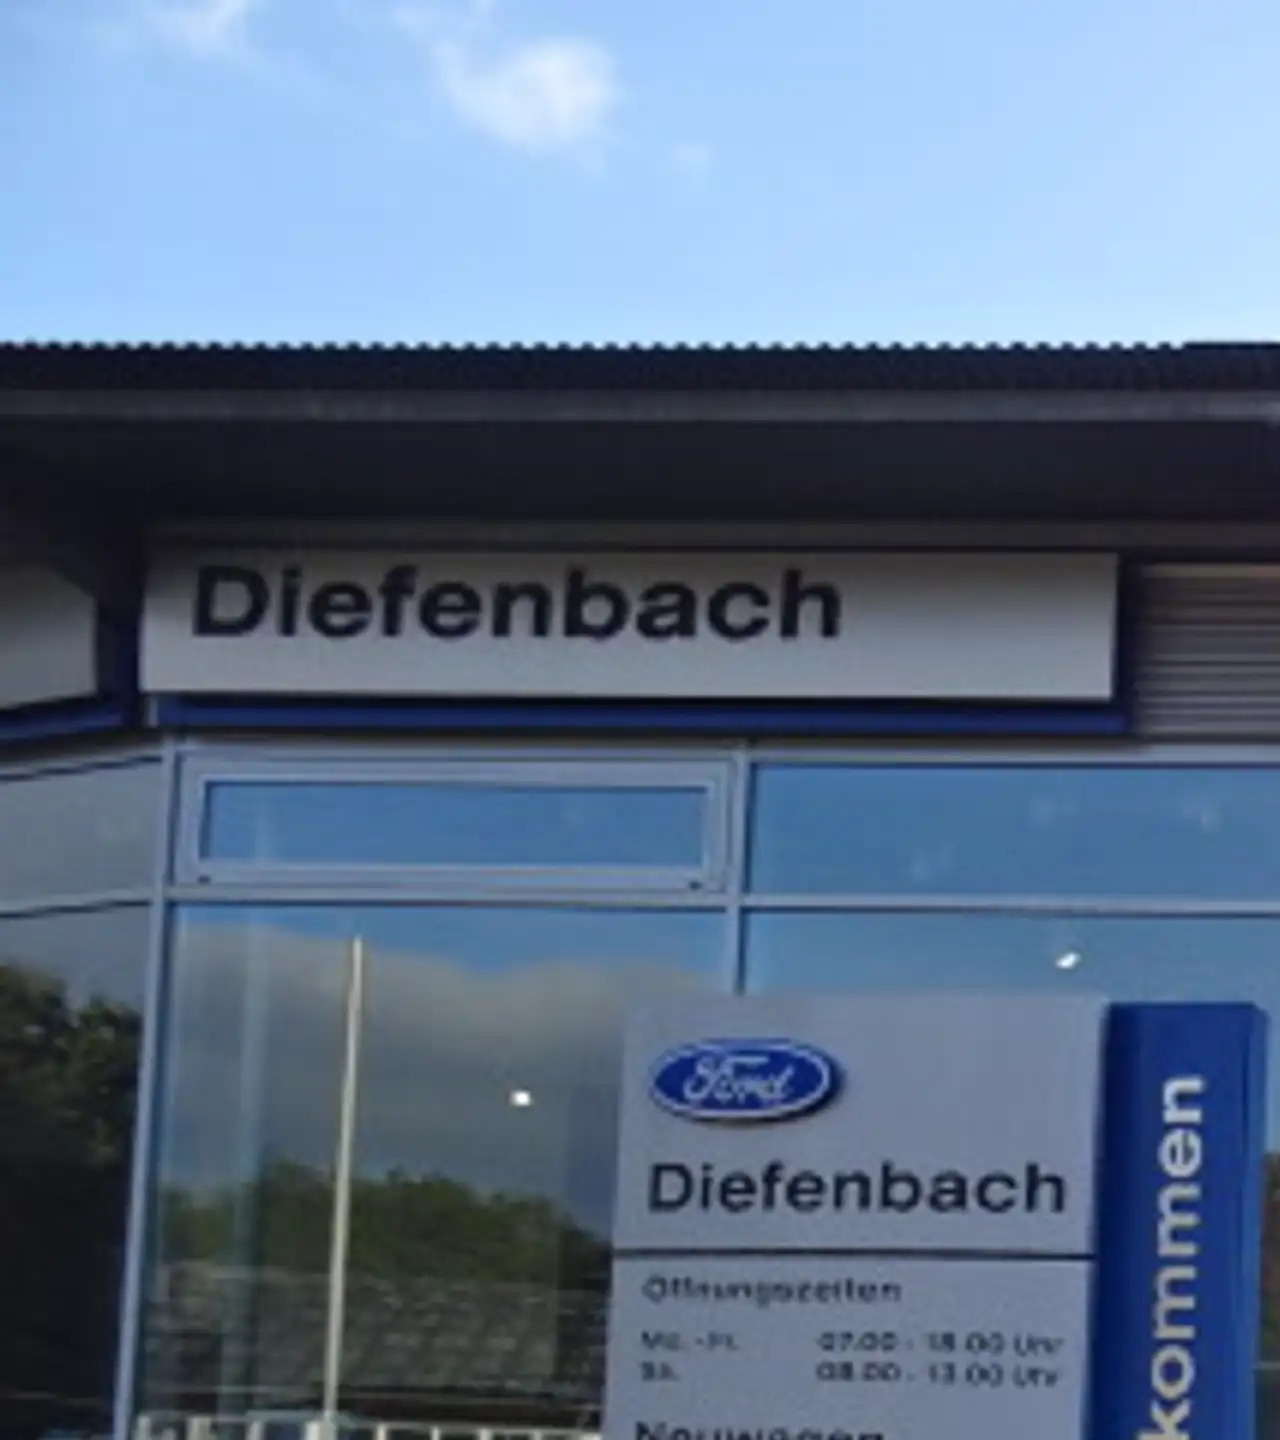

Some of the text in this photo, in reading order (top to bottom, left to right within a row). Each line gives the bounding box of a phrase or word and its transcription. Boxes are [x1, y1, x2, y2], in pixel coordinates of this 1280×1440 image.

[192, 565, 841, 640] Diefenbach
[683, 1052, 794, 1103] Ford
[647, 1162, 1067, 1213] Diefenbach
